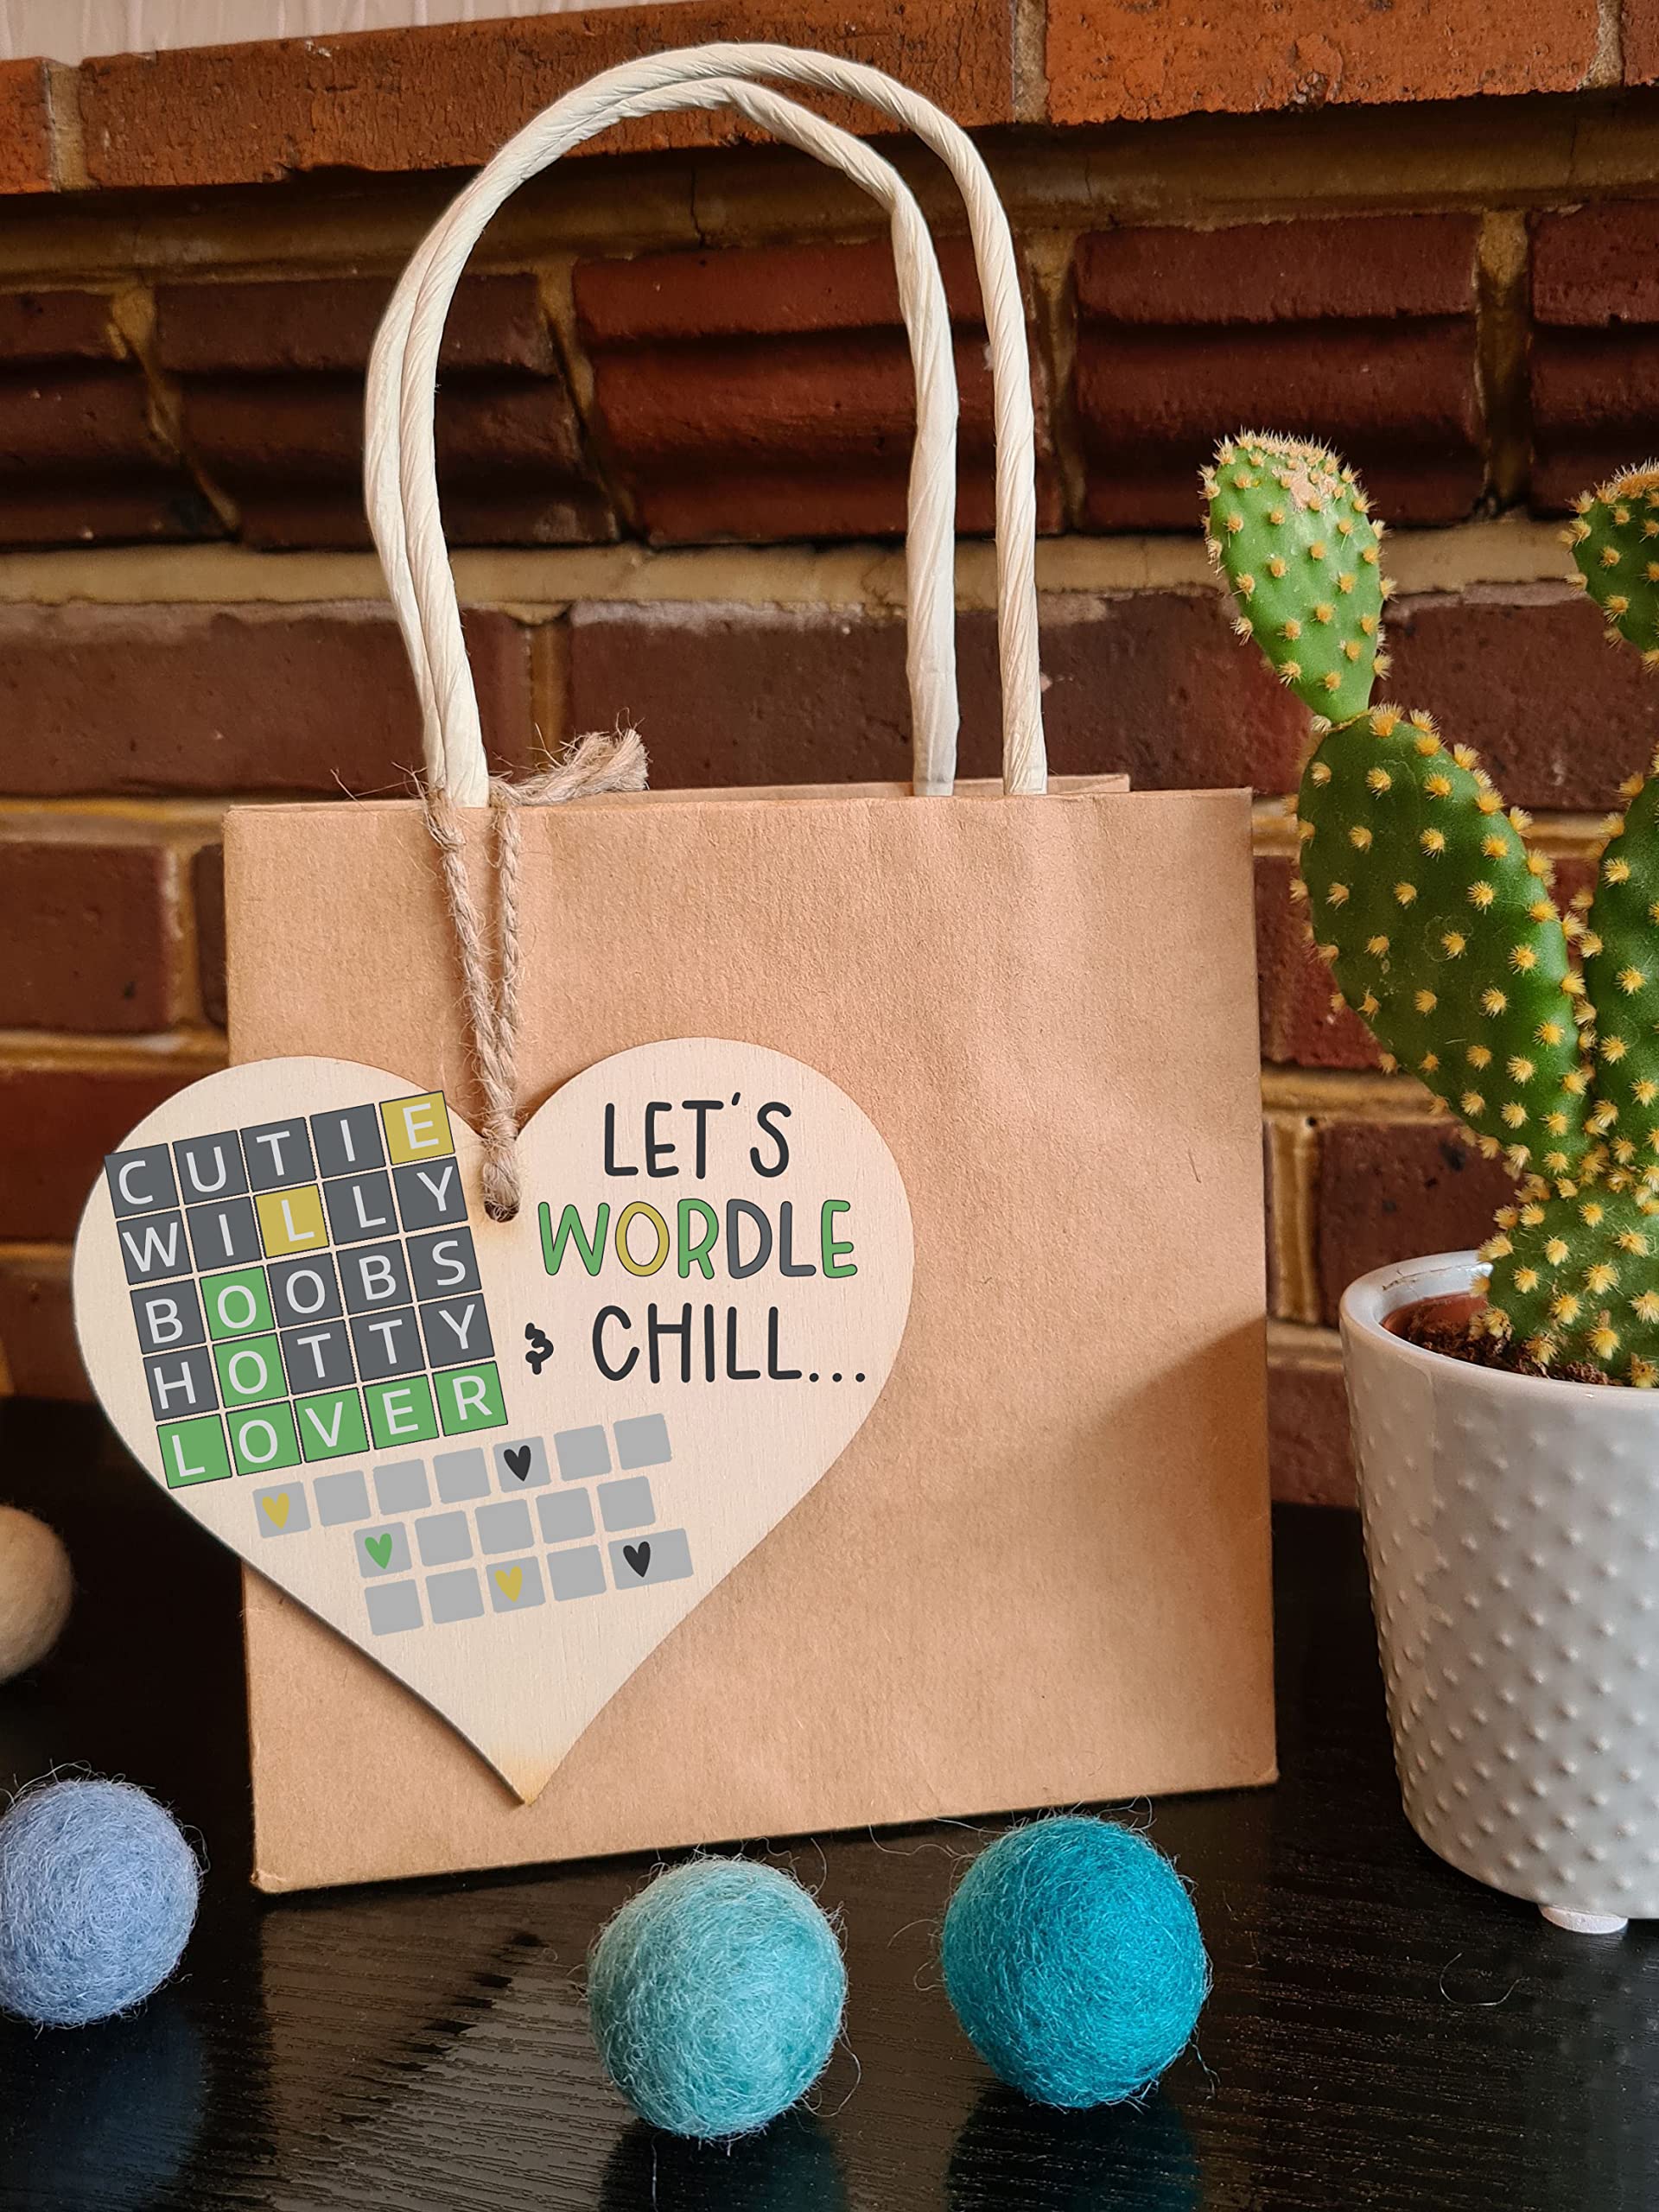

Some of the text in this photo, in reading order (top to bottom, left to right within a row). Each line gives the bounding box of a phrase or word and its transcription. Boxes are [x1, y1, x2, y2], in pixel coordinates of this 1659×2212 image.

[118, 1103, 439, 1205] CUTIE
[605, 1092, 791, 1179] LET'S
[123, 1166, 454, 1272] WILLY
[538, 1198, 858, 1280] WORDLE
[145, 1240, 466, 1344] BOOBS
[593, 1303, 866, 1383] CHILL...
[153, 1305, 475, 1409] HOTTY
[172, 1375, 493, 1477] LOVER
